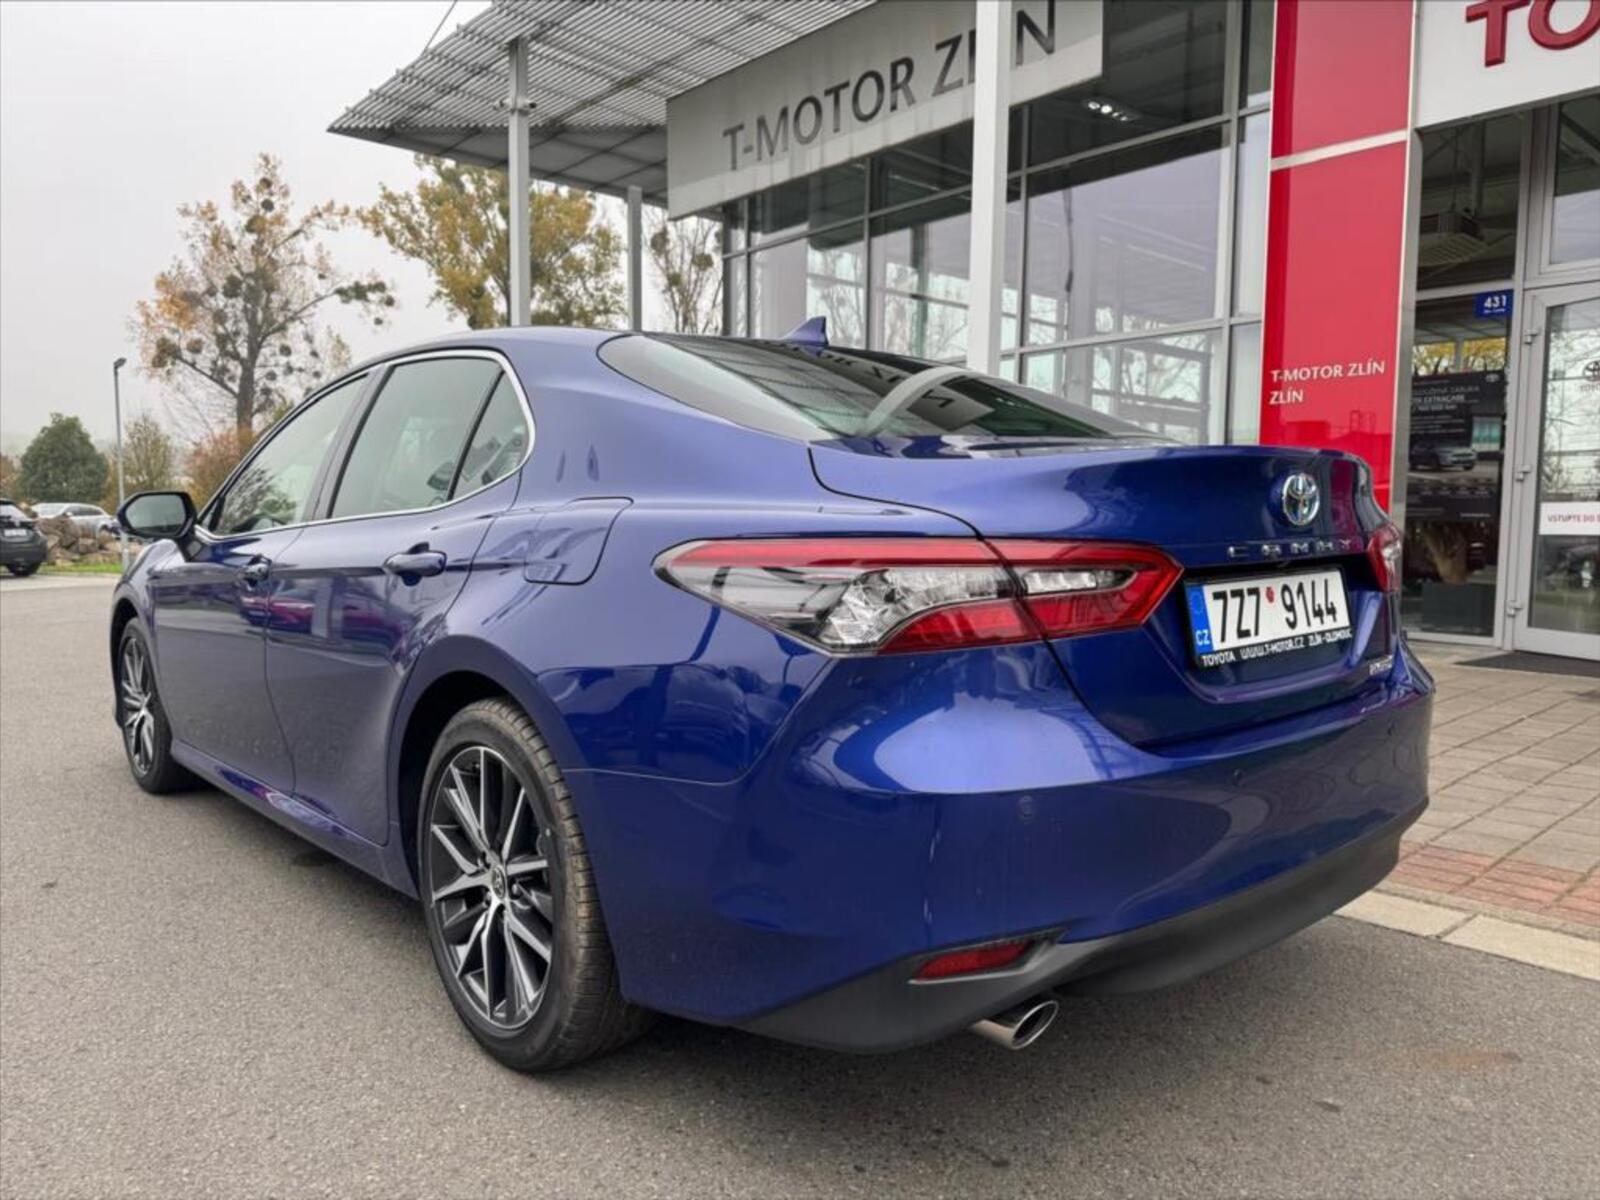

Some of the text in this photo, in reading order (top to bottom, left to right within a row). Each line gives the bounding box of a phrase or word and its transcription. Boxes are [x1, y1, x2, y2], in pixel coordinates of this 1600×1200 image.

[722, 56, 917, 171] T-MOTOR
[1484, 295, 1506, 308] 431
[1270, 358, 1385, 382] T-MOTOR ZLÍN
[1269, 387, 1303, 405] ZLÍN
[1212, 578, 1338, 643] 7Z7 9144
[1195, 630, 1211, 645] CZ
[1202, 651, 1236, 667] TOYOTA
